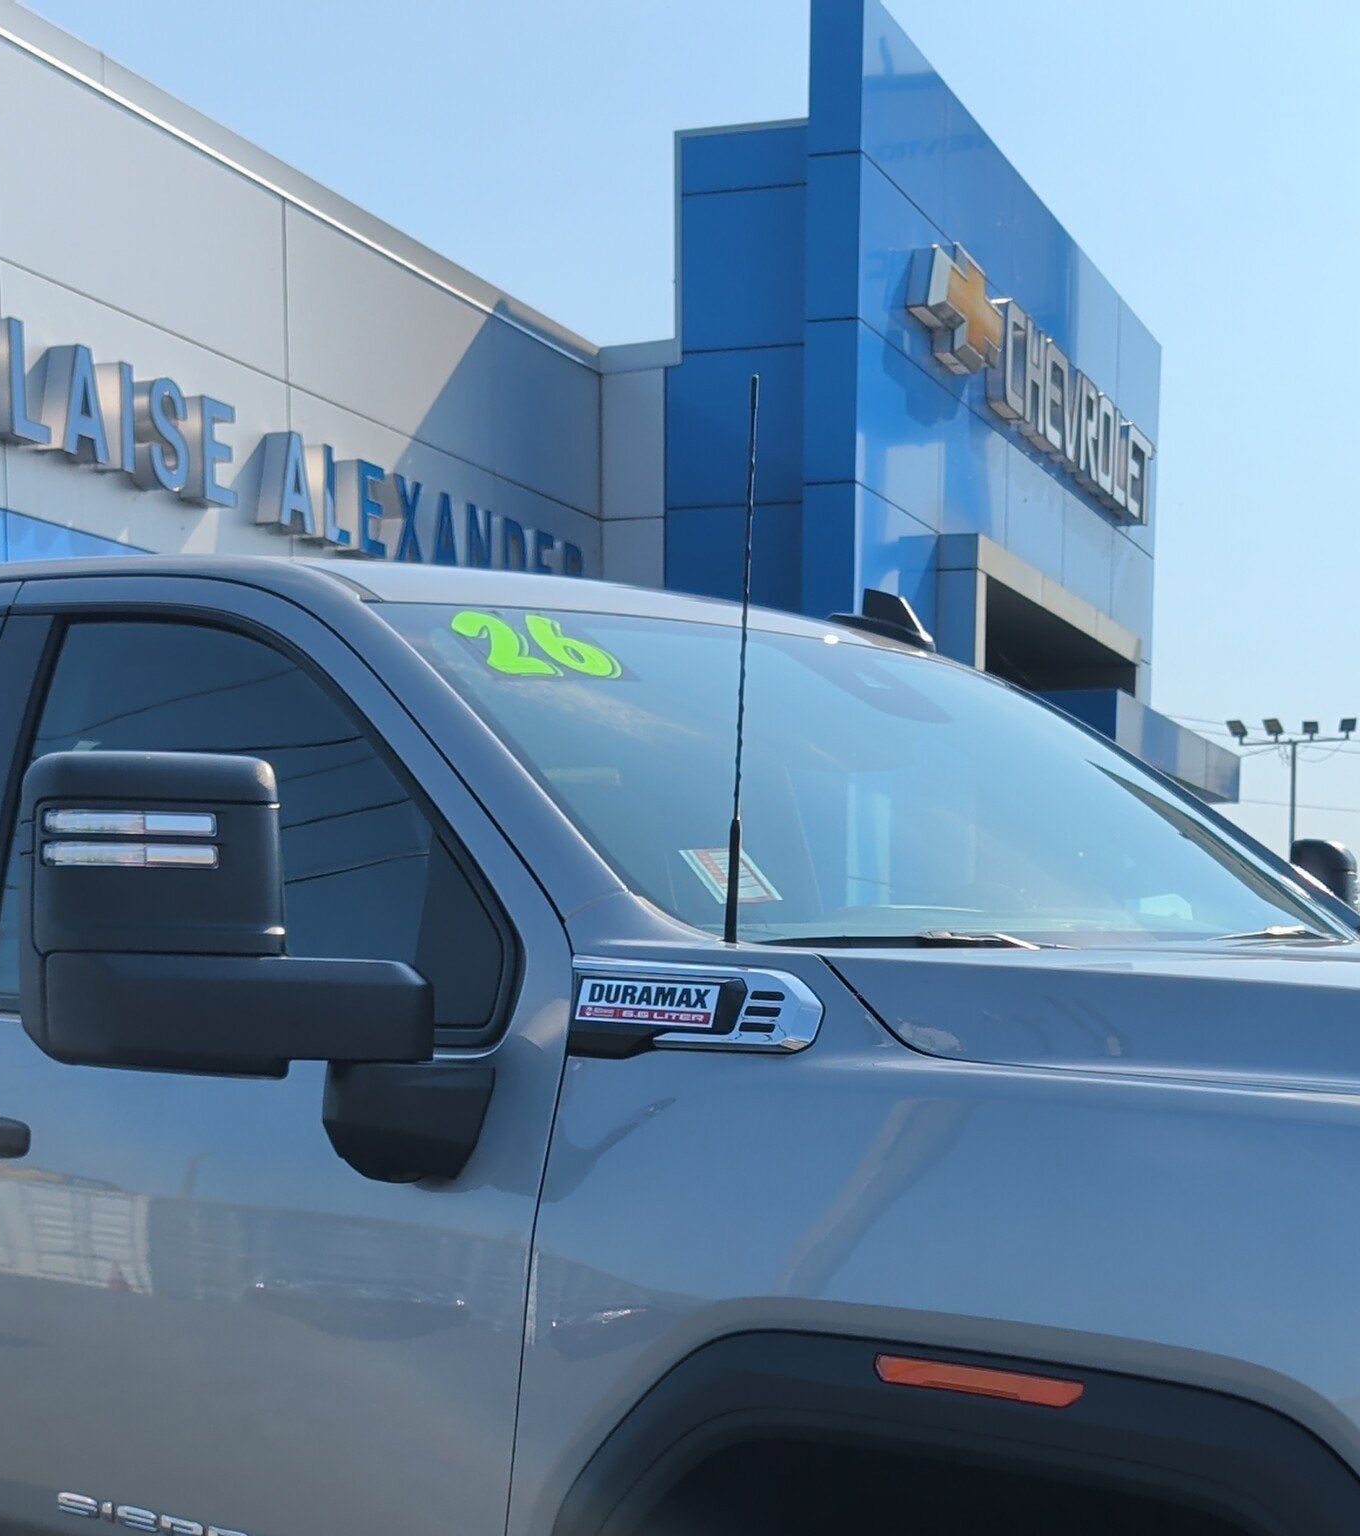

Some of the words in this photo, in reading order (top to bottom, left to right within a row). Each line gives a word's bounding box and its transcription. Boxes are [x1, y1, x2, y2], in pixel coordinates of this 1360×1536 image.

[1000, 299, 1157, 528] CHEVROLET
[451, 610, 624, 679] 26
[588, 983, 712, 1009] DURAMAX
[652, 1011, 705, 1022] LITER
